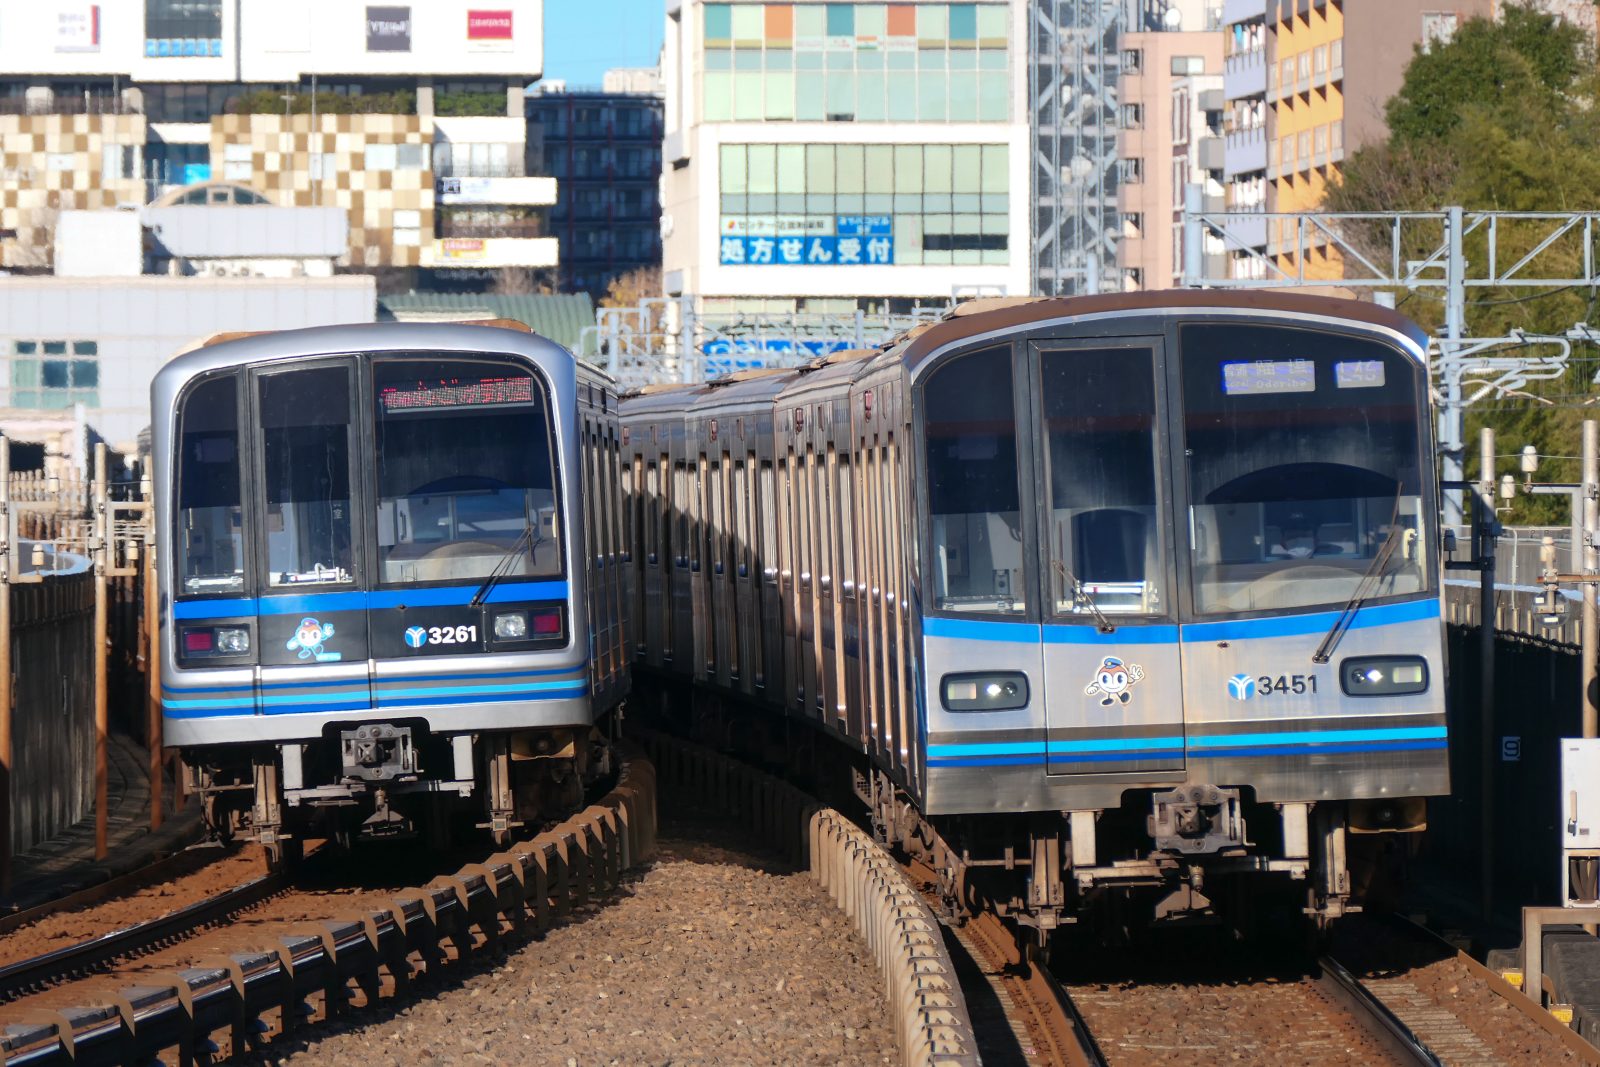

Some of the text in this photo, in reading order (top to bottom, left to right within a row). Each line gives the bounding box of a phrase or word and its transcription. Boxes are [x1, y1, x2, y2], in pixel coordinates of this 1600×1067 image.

[721, 238, 892, 263] 処方せん受付
[428, 625, 477, 645] 3261
[1258, 674, 1317, 696] 3451
